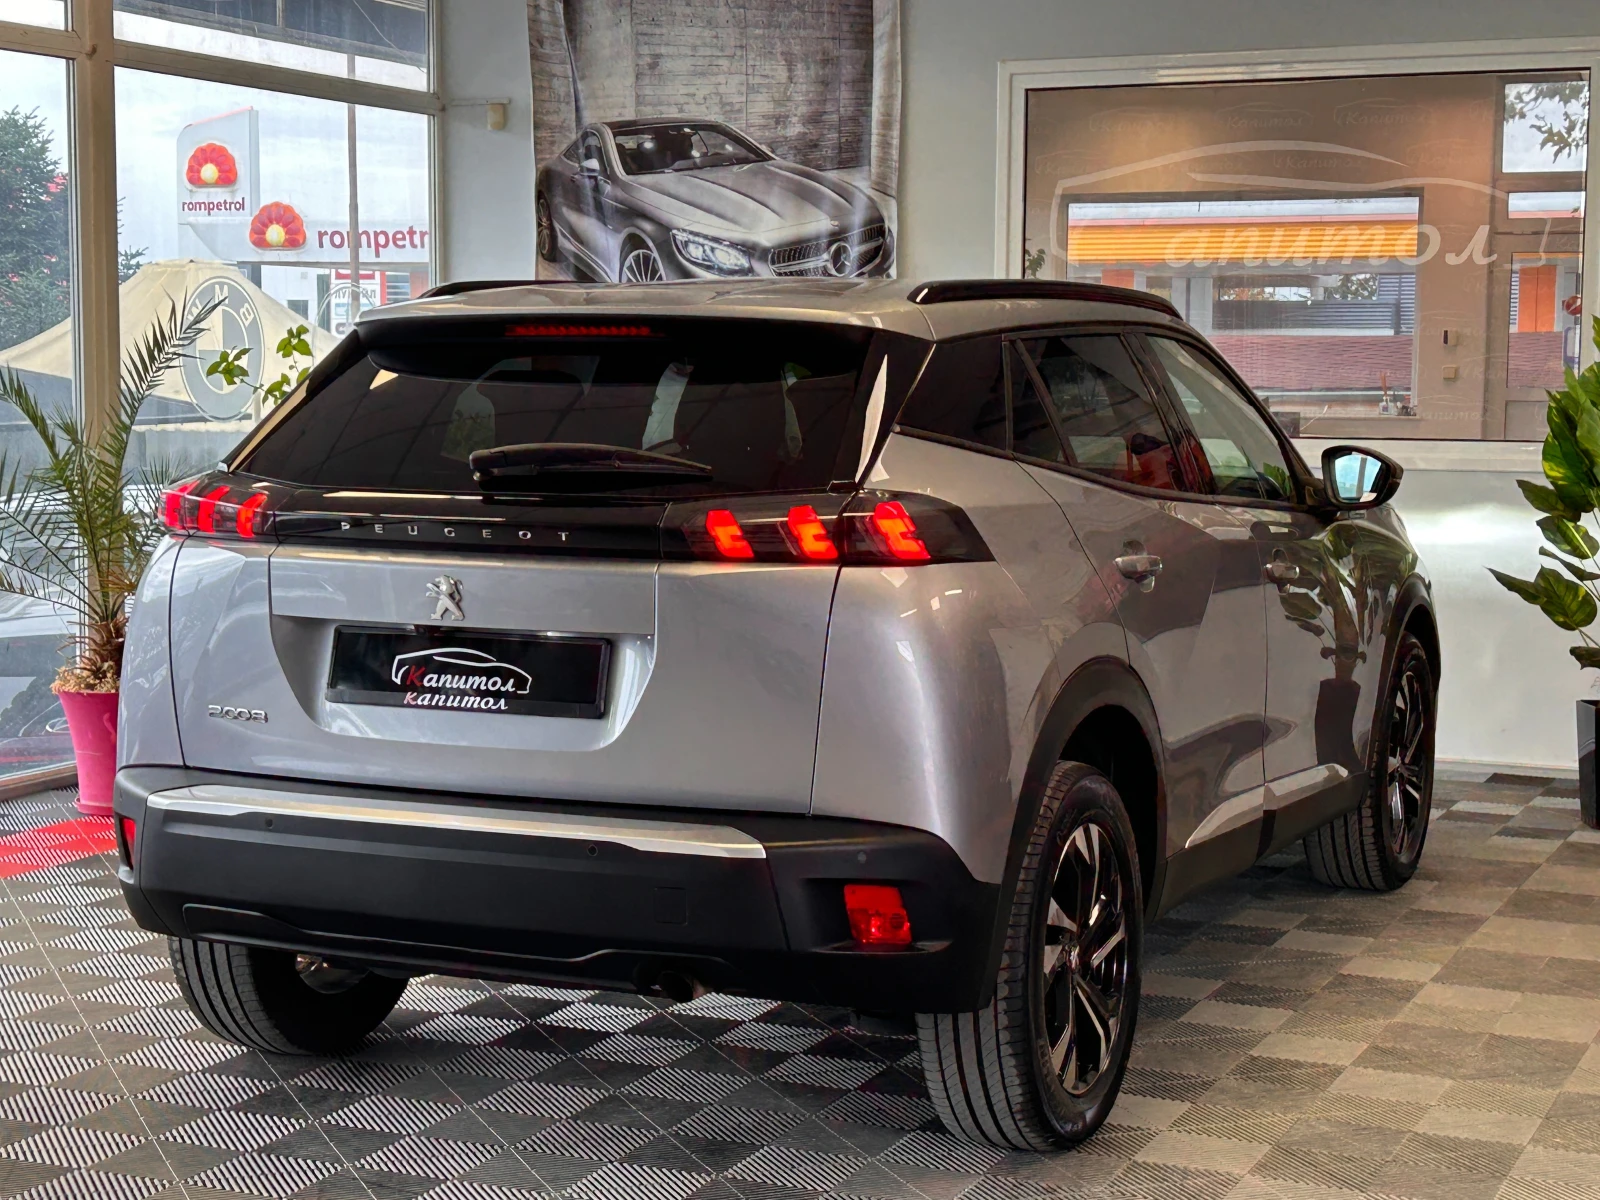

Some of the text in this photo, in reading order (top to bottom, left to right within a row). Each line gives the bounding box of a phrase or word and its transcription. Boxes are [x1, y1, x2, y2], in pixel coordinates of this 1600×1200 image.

[182, 197, 245, 216] rompetrol
[1164, 222, 1498, 268] апитол
[340, 521, 569, 542] PEUGEOT
[406, 664, 516, 692] Капитол
[208, 704, 268, 723] 2008
